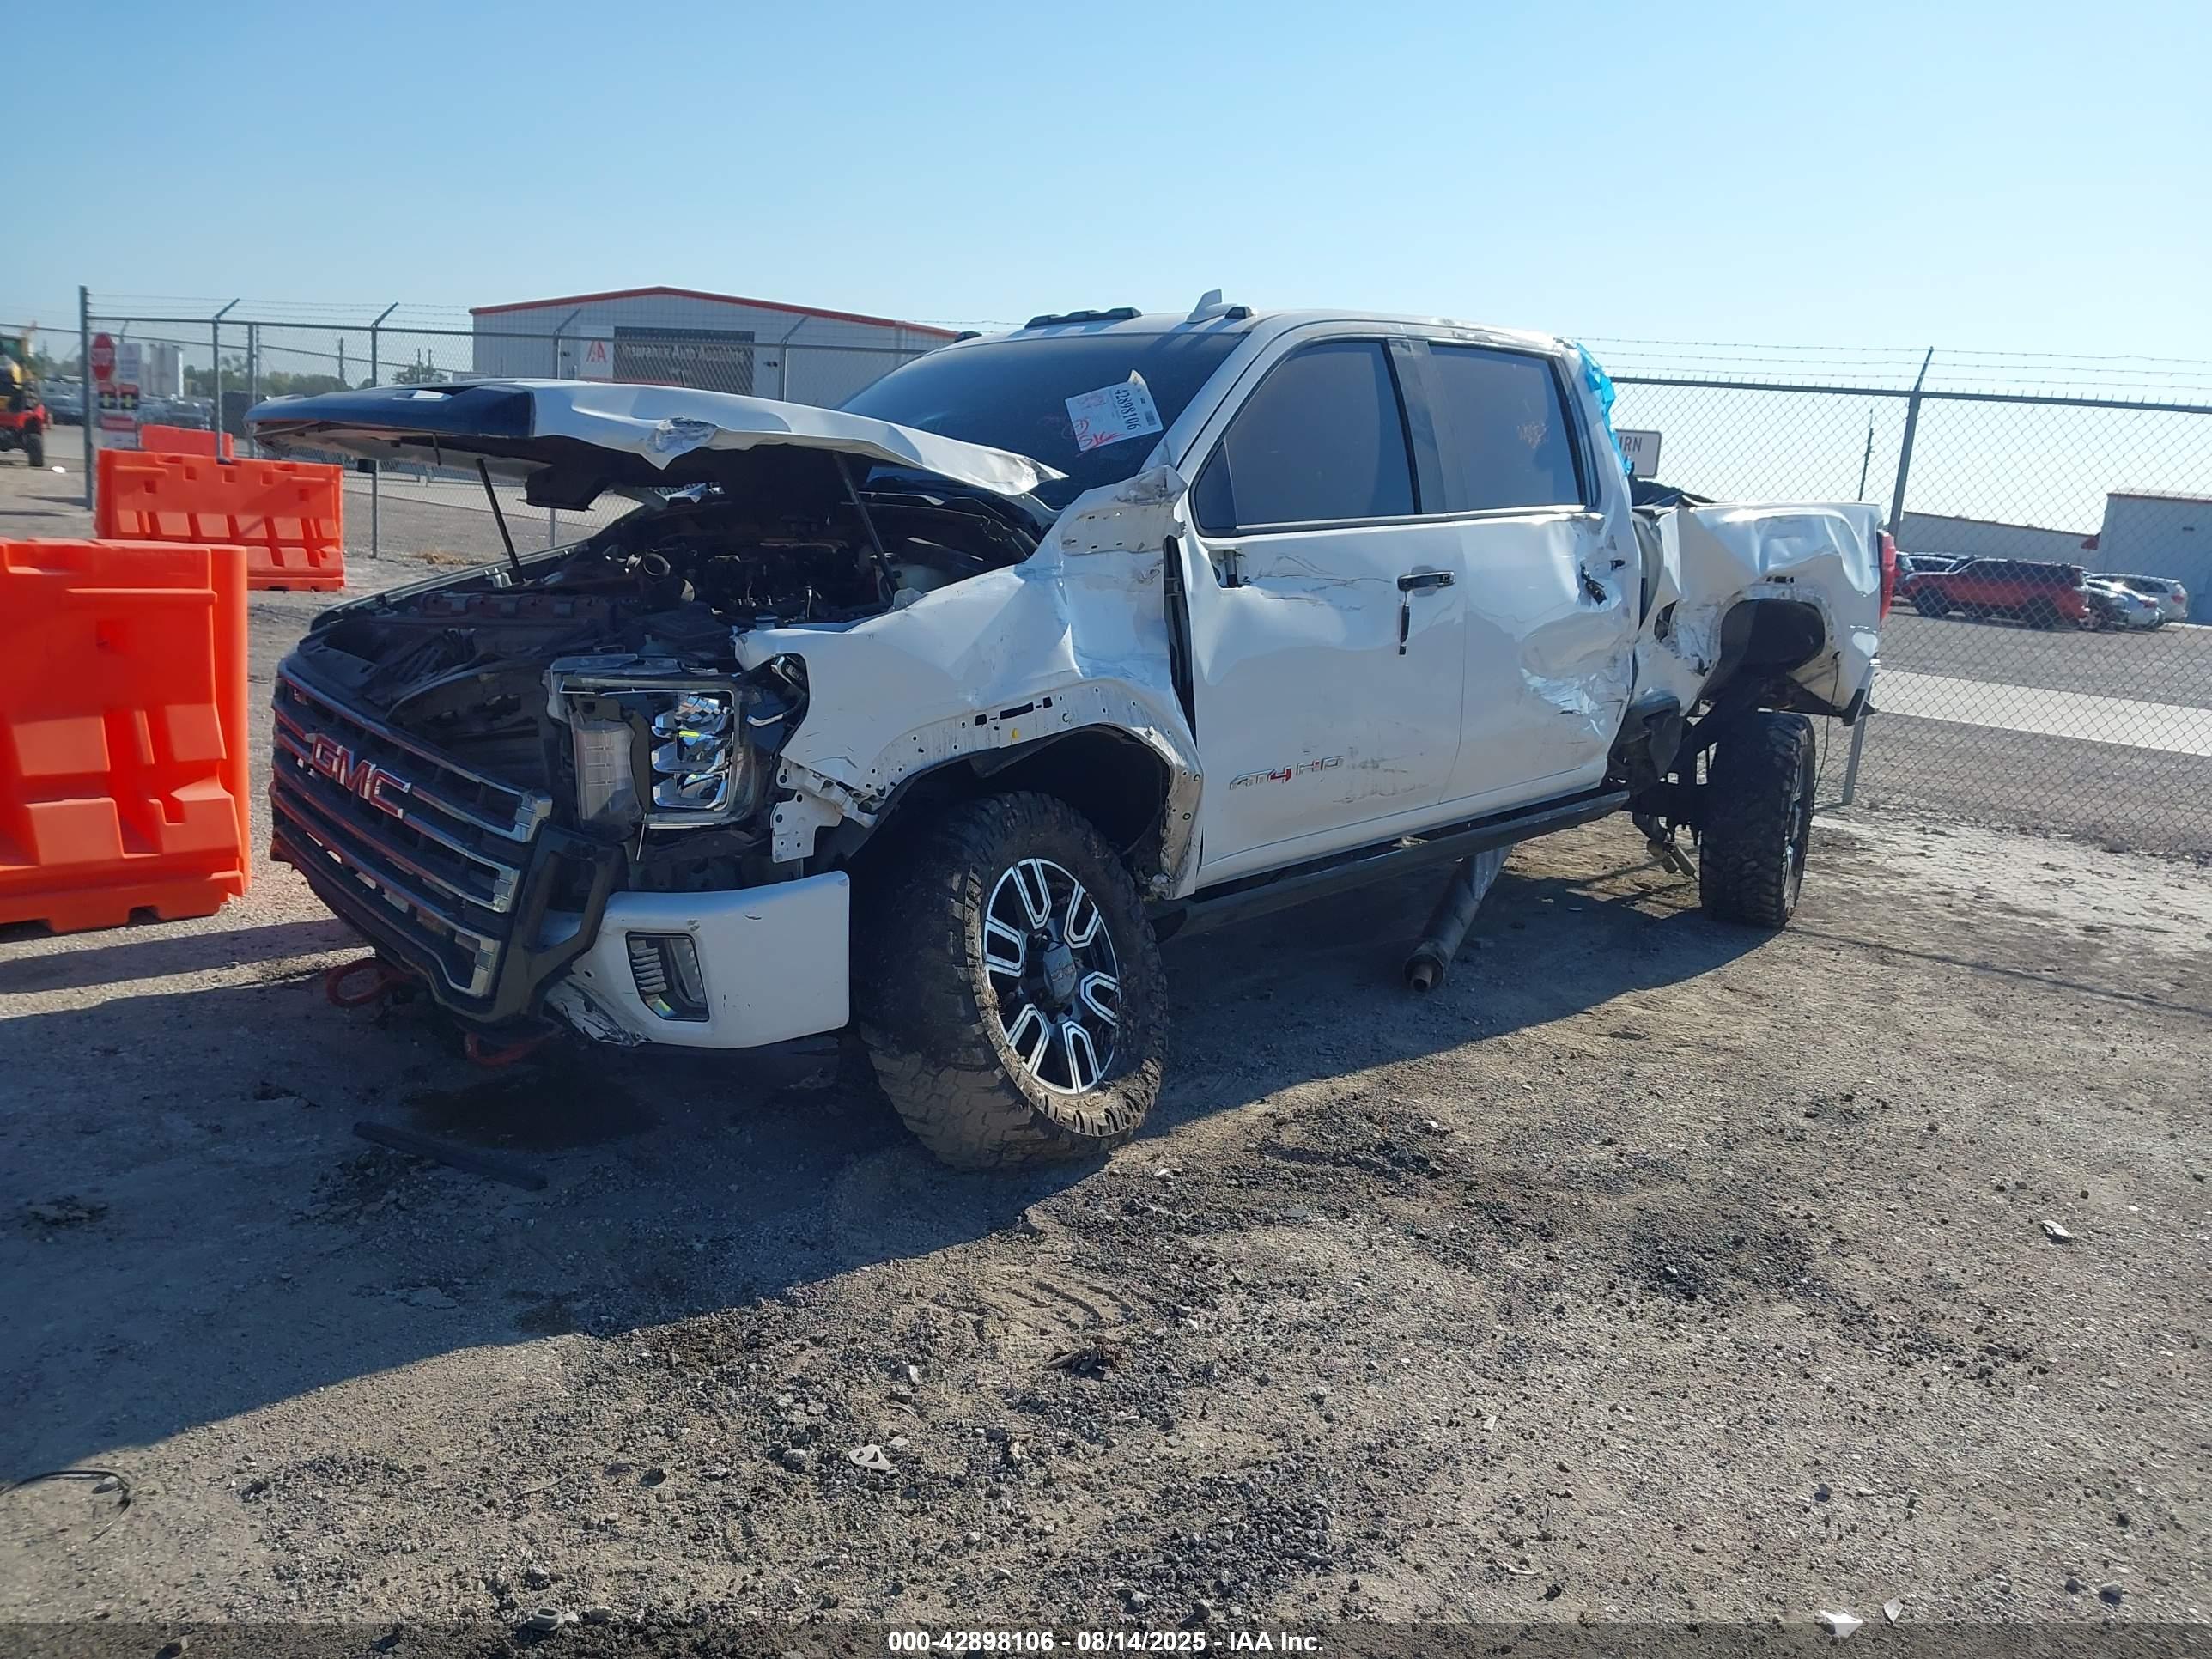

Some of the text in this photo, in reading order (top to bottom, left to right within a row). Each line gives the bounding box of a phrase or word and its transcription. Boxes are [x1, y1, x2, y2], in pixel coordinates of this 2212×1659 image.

[1115, 389, 1142, 431] 42898106
[312, 732, 411, 819] GMC
[1229, 756, 1344, 790] AT4 HD
